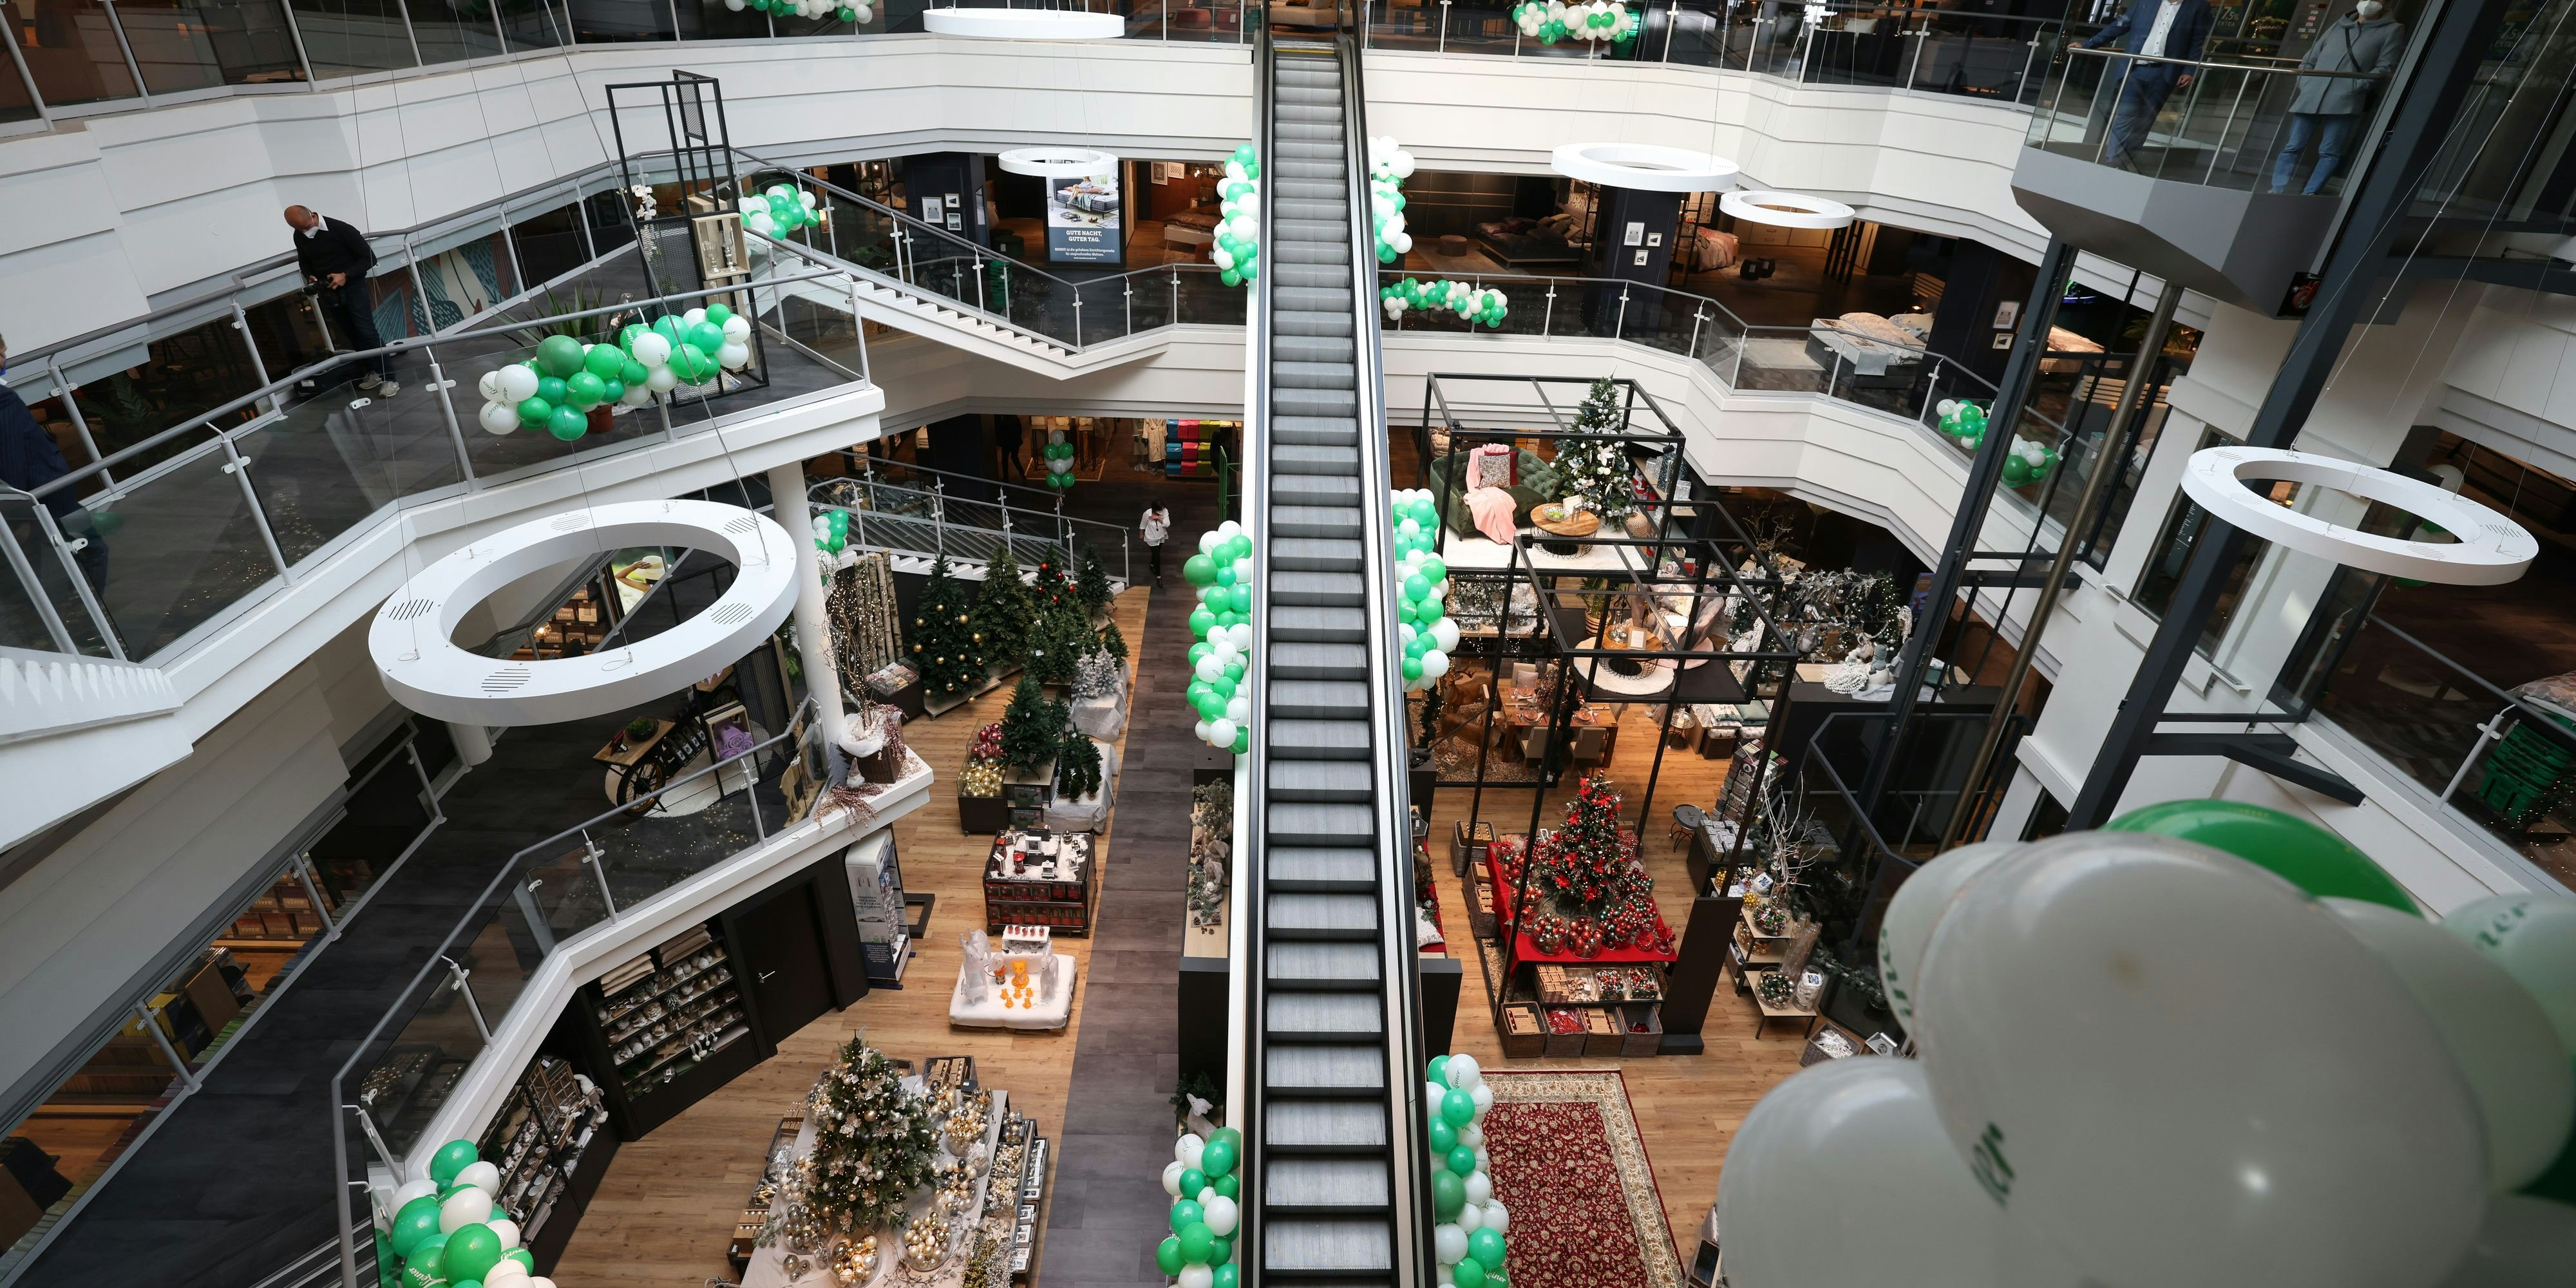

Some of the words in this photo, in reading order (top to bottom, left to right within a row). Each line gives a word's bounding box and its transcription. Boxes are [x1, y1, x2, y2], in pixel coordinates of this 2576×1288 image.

[1451, 1069, 1461, 1089] Leiner
[1482, 1200, 1504, 1211] Leiner
[1484, 1269, 1506, 1283] Leiner
